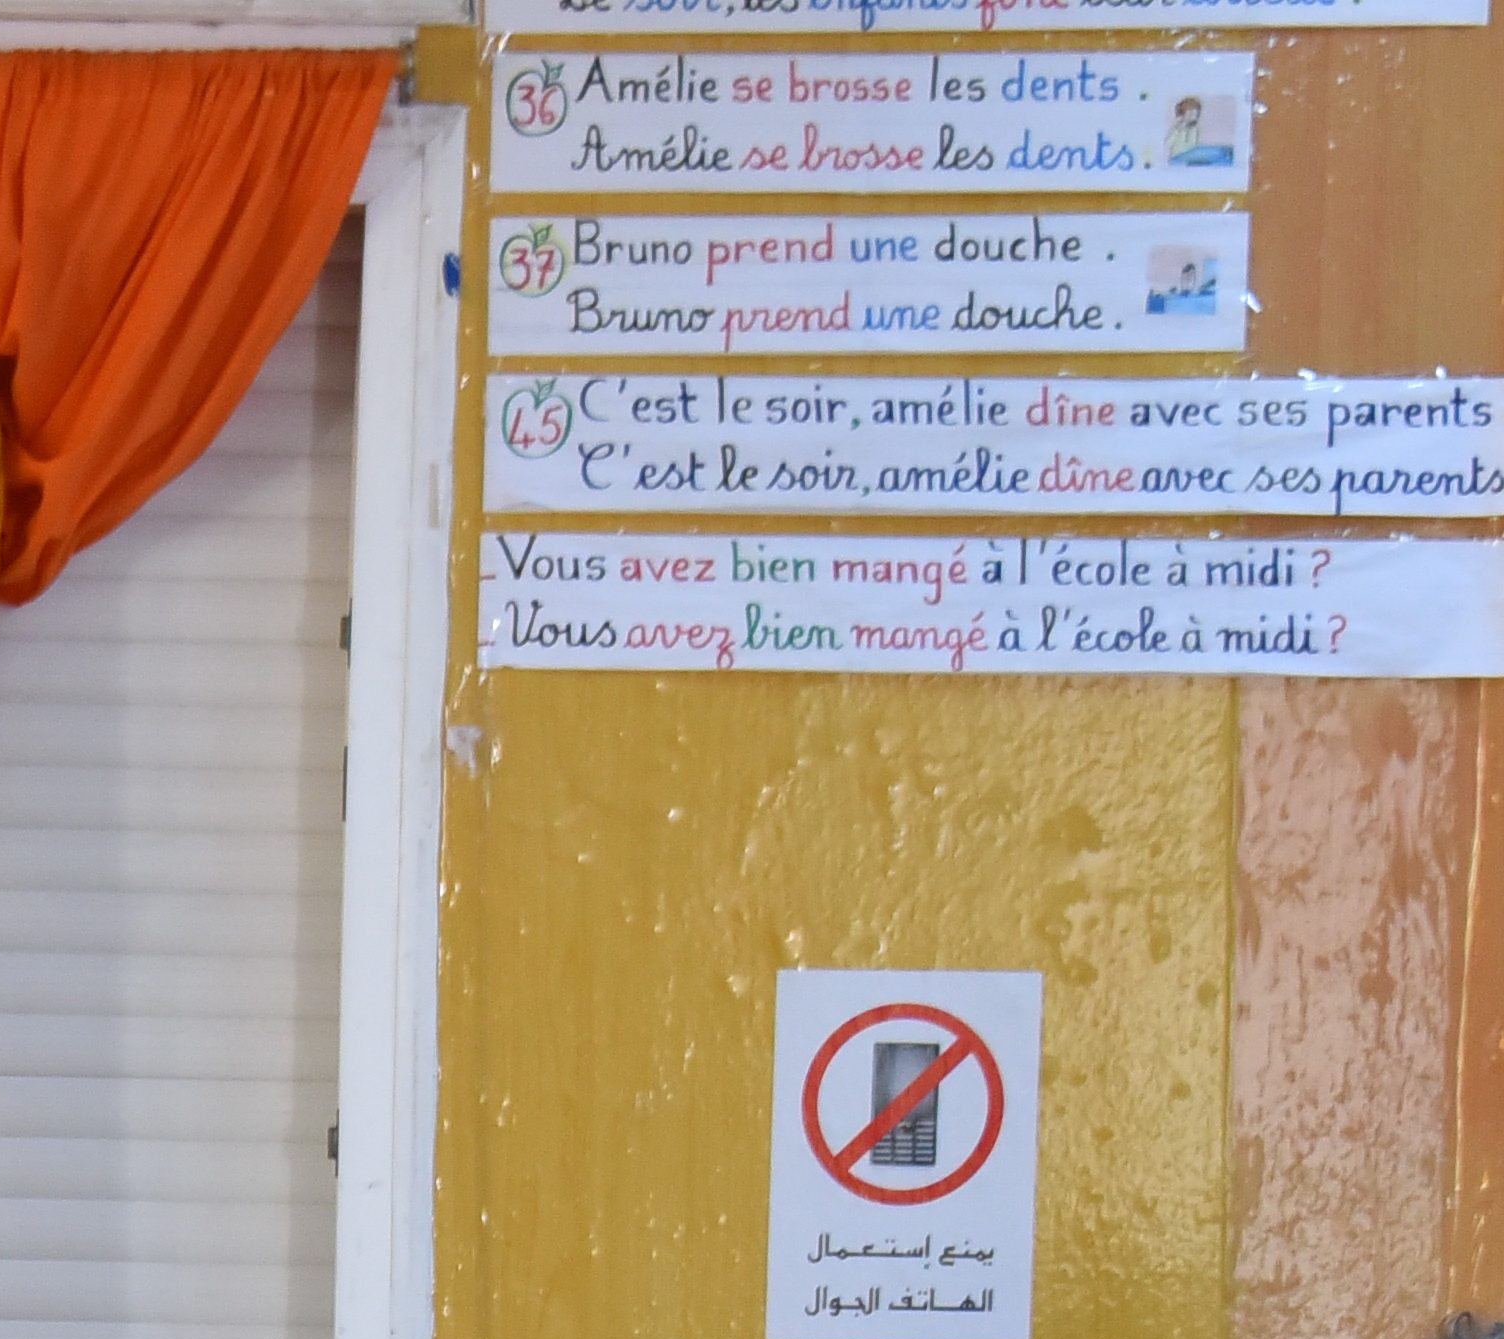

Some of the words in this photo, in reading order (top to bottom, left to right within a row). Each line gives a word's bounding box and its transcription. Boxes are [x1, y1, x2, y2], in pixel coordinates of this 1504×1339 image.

[512, 80, 558, 126] 36
[573, 53, 718, 103] Amélie
[732, 76, 772, 103] se
[789, 60, 911, 102] brosse
[928, 57, 986, 102] les
[571, 124, 733, 172] Amélie
[739, 145, 789, 170] se
[798, 122, 924, 171] brosse
[932, 123, 994, 171] les
[506, 242, 558, 291] 37
[572, 217, 694, 266] Bruno
[706, 226, 833, 286] prend
[850, 236, 918, 263] une
[566, 286, 715, 333] Bruno
[719, 290, 852, 352] prend
[862, 304, 940, 330] une
[507, 402, 564, 450] 45
[578, 377, 699, 424] C'est
[716, 378, 754, 424] le
[871, 378, 1009, 426] amélie
[1026, 386, 1115, 426] dîne
[1130, 402, 1221, 427] avec
[1237, 400, 1307, 427] ses
[716, 443, 758, 492] le
[876, 446, 1029, 493] amélie
[1038, 452, 1135, 493] dîne
[1139, 466, 1235, 493] avec
[1244, 465, 1321, 494] ses
[496, 534, 607, 581] Vous
[620, 558, 716, 582] avez
[731, 539, 814, 582] bien
[833, 543, 967, 605] mangé
[980, 541, 1005, 584] à
[1166, 540, 1188, 587] à
[1206, 547, 1295, 587] midi
[505, 599, 617, 648] Vous
[622, 624, 740, 668] avez
[741, 603, 843, 650] bien
[849, 611, 989, 671] mangé
[997, 609, 1026, 651] à
[1179, 615, 1204, 653] à
[938, 1241, 994, 1266] يمنع
[805, 1286, 881, 1317] الجوال
[888, 1288, 993, 1312] الهاتف
